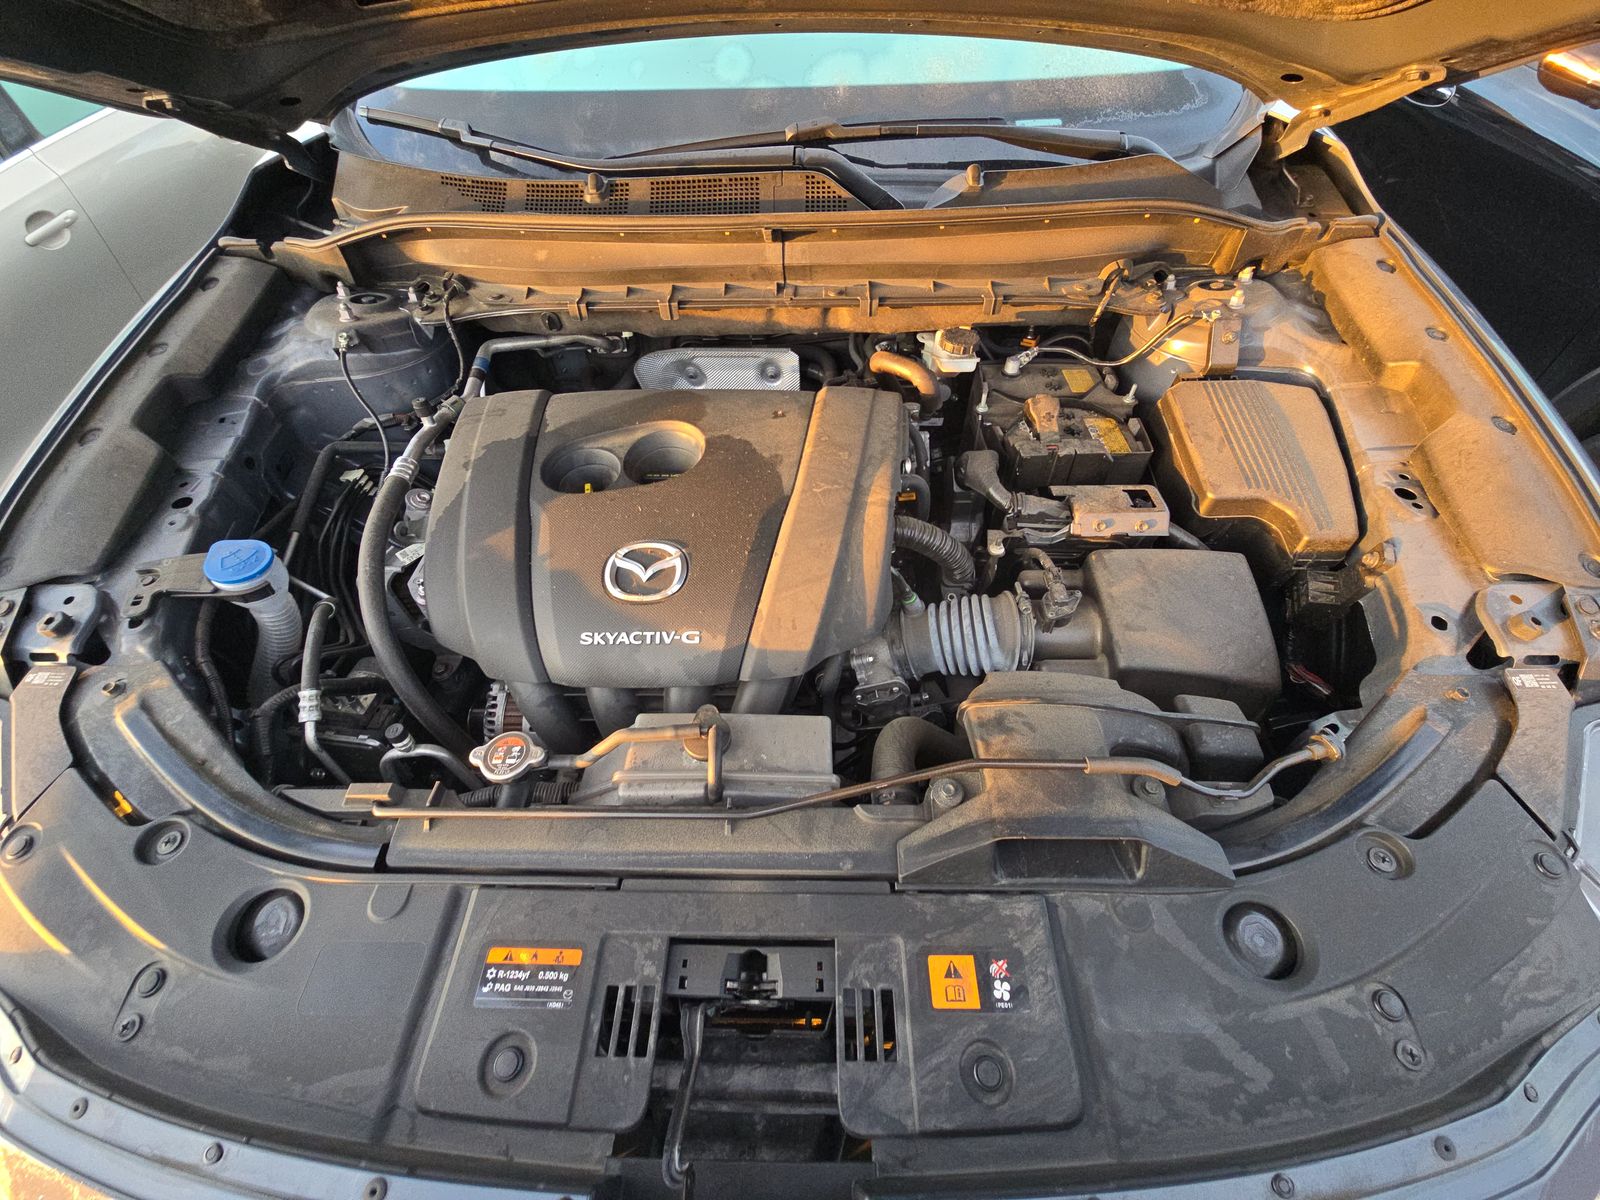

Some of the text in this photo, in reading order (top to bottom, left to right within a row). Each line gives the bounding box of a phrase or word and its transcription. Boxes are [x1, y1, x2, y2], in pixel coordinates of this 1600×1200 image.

[579, 630, 701, 645] SKYACTIV-G
[497, 969, 569, 982] R-1234yf 0.500 kg
[494, 982, 511, 992] PAG
